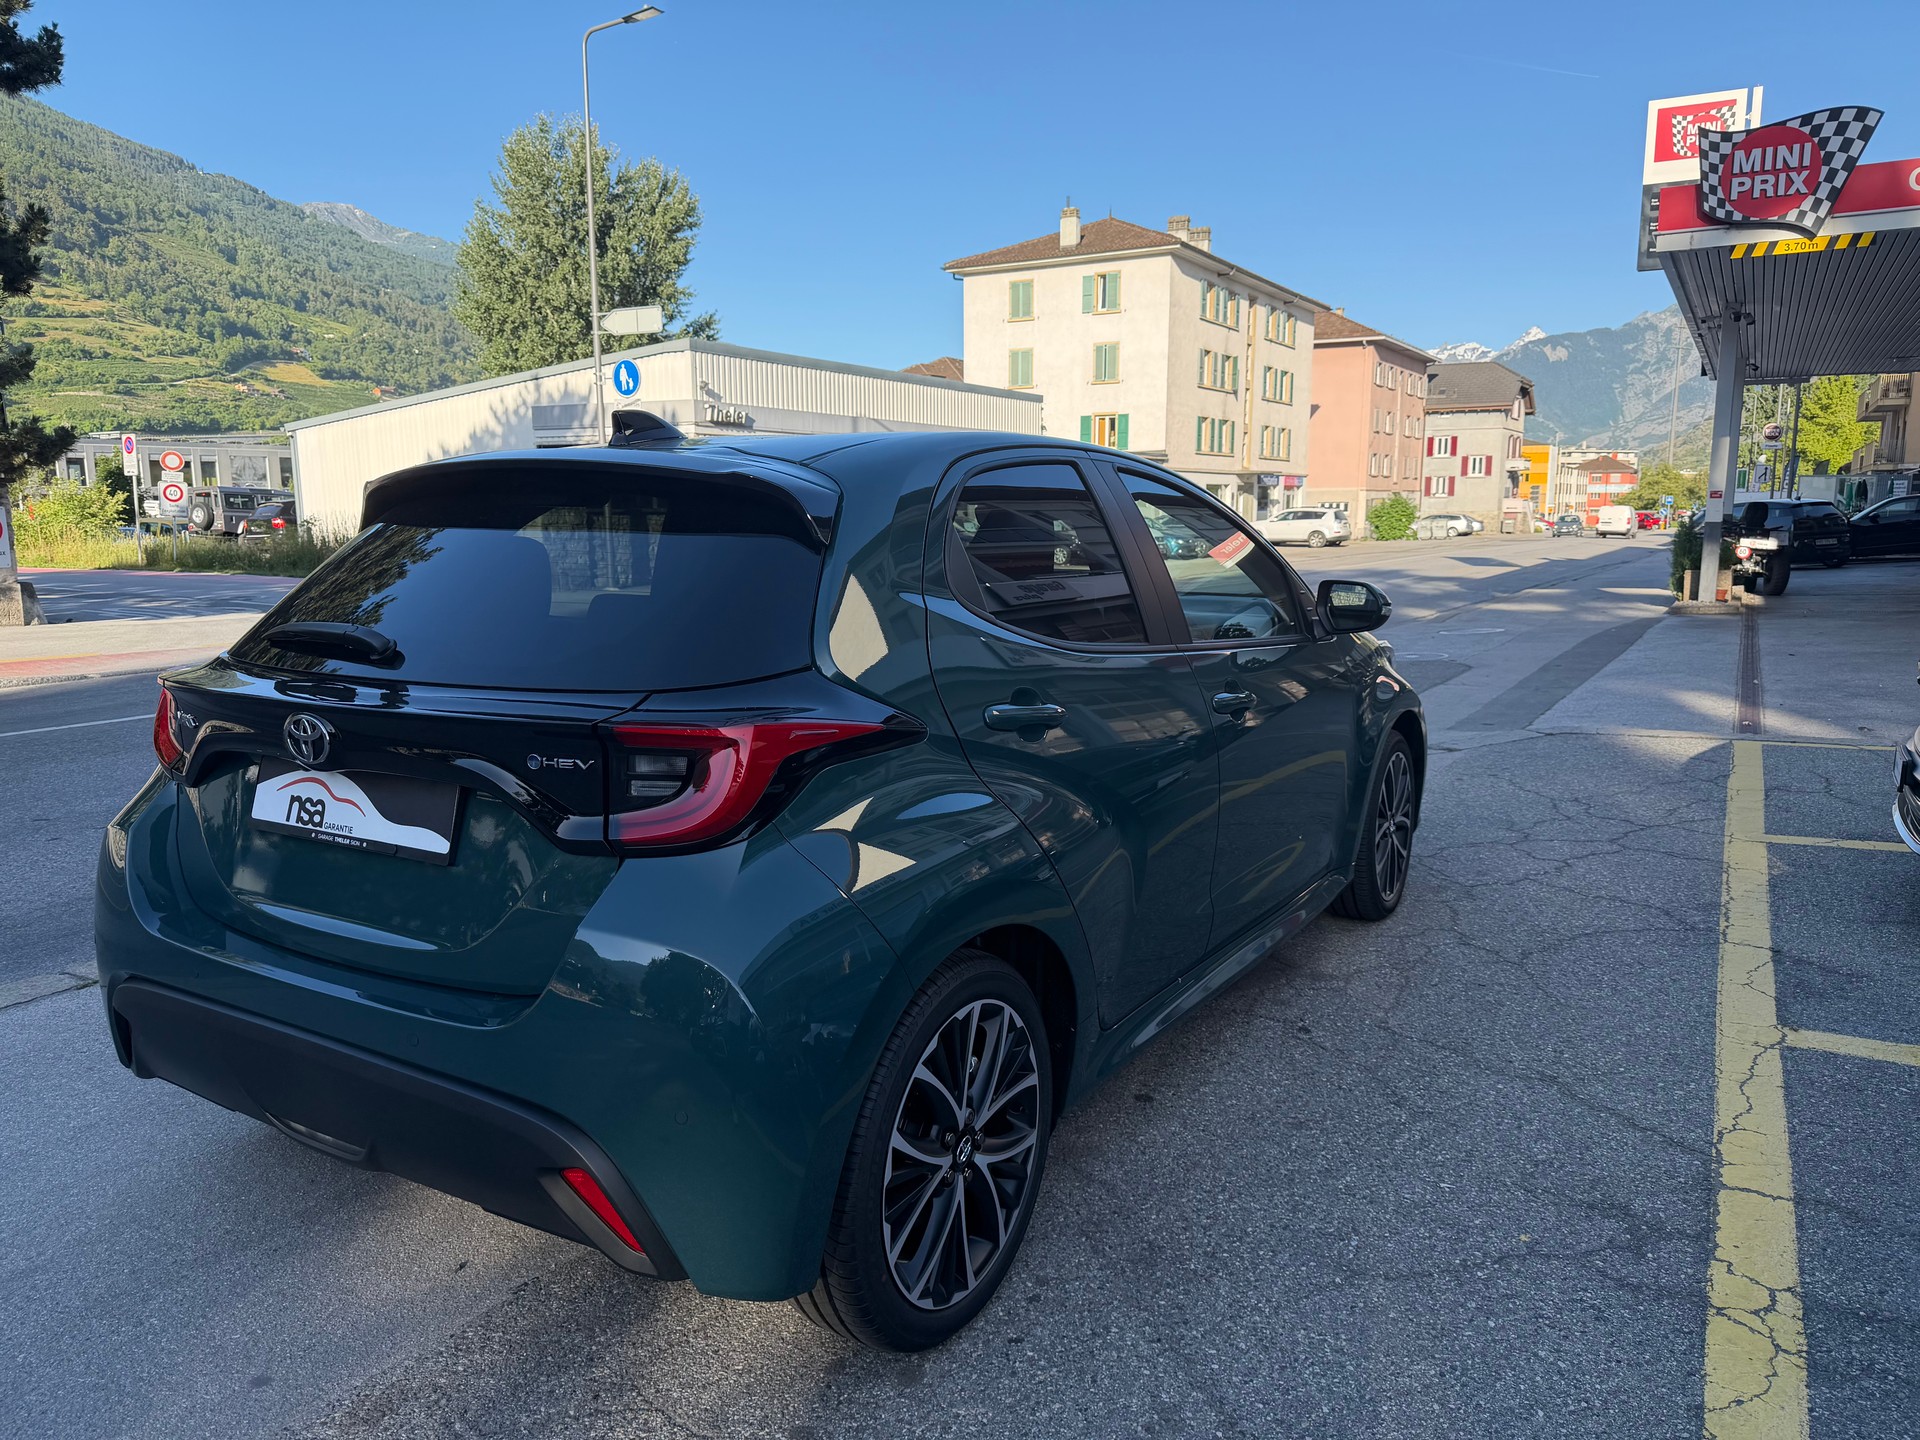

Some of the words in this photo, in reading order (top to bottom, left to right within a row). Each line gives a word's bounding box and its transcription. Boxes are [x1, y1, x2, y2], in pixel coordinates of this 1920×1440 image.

[1732, 142, 1812, 174] MINI
[1729, 170, 1810, 201] PRIX
[543, 757, 595, 770] HEV
[285, 794, 326, 828] nsa
[317, 833, 334, 842] GARAGE
[324, 821, 354, 834] GARANTIE
